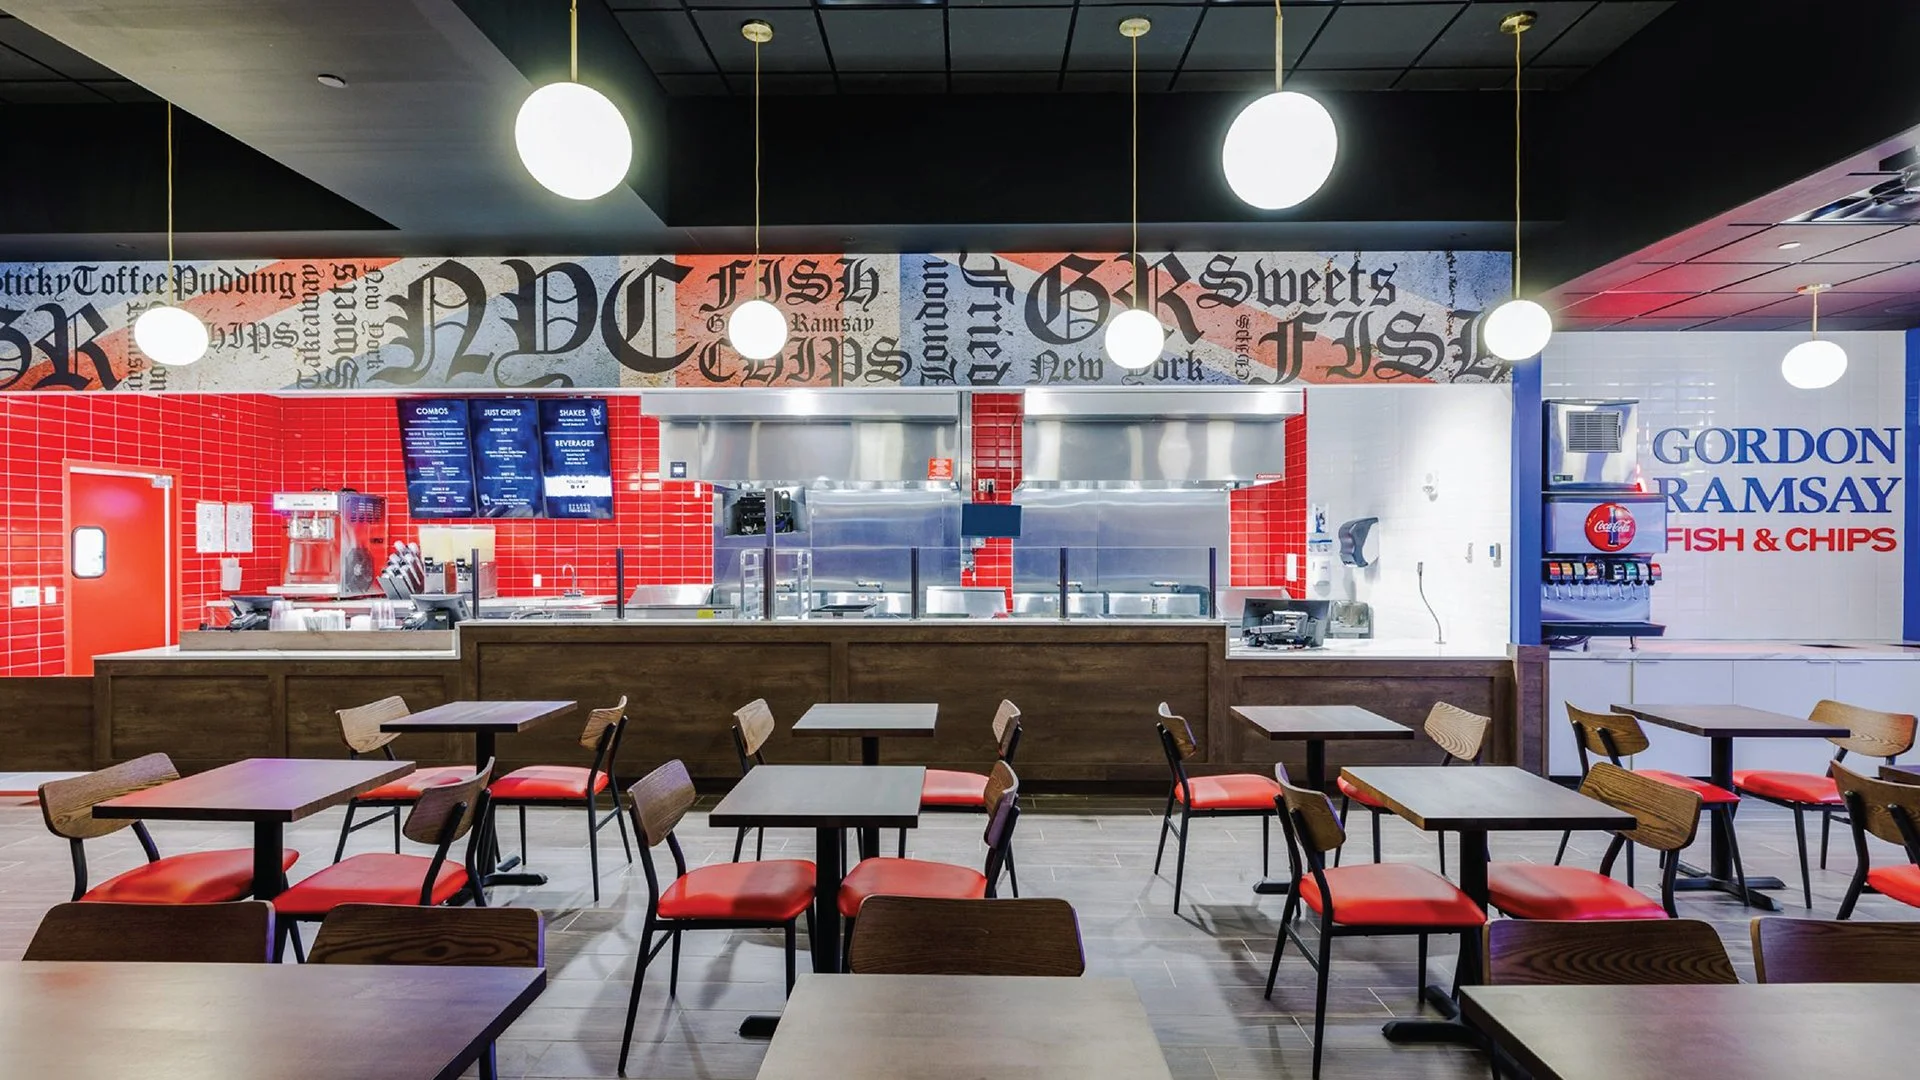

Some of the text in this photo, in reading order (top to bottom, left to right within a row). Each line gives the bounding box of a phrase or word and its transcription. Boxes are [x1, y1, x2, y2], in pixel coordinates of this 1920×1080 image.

[361, 263, 385, 371] New York
[1024, 253, 1205, 345] GR
[1197, 254, 1397, 309] Sweets
[205, 320, 300, 354] HIPS
[296, 264, 325, 389] Takeaway
[325, 263, 360, 389] Sweets
[366, 258, 698, 387] NYC
[790, 312, 875, 336] Ramsay
[915, 259, 957, 386] London
[958, 252, 1015, 386] Fried
[1025, 350, 1104, 384] New
[1652, 427, 1903, 465] GORDON
[1652, 476, 1903, 514] RAMSAY
[1753, 527, 1781, 552] &
[1785, 527, 1898, 552] CHIPS
